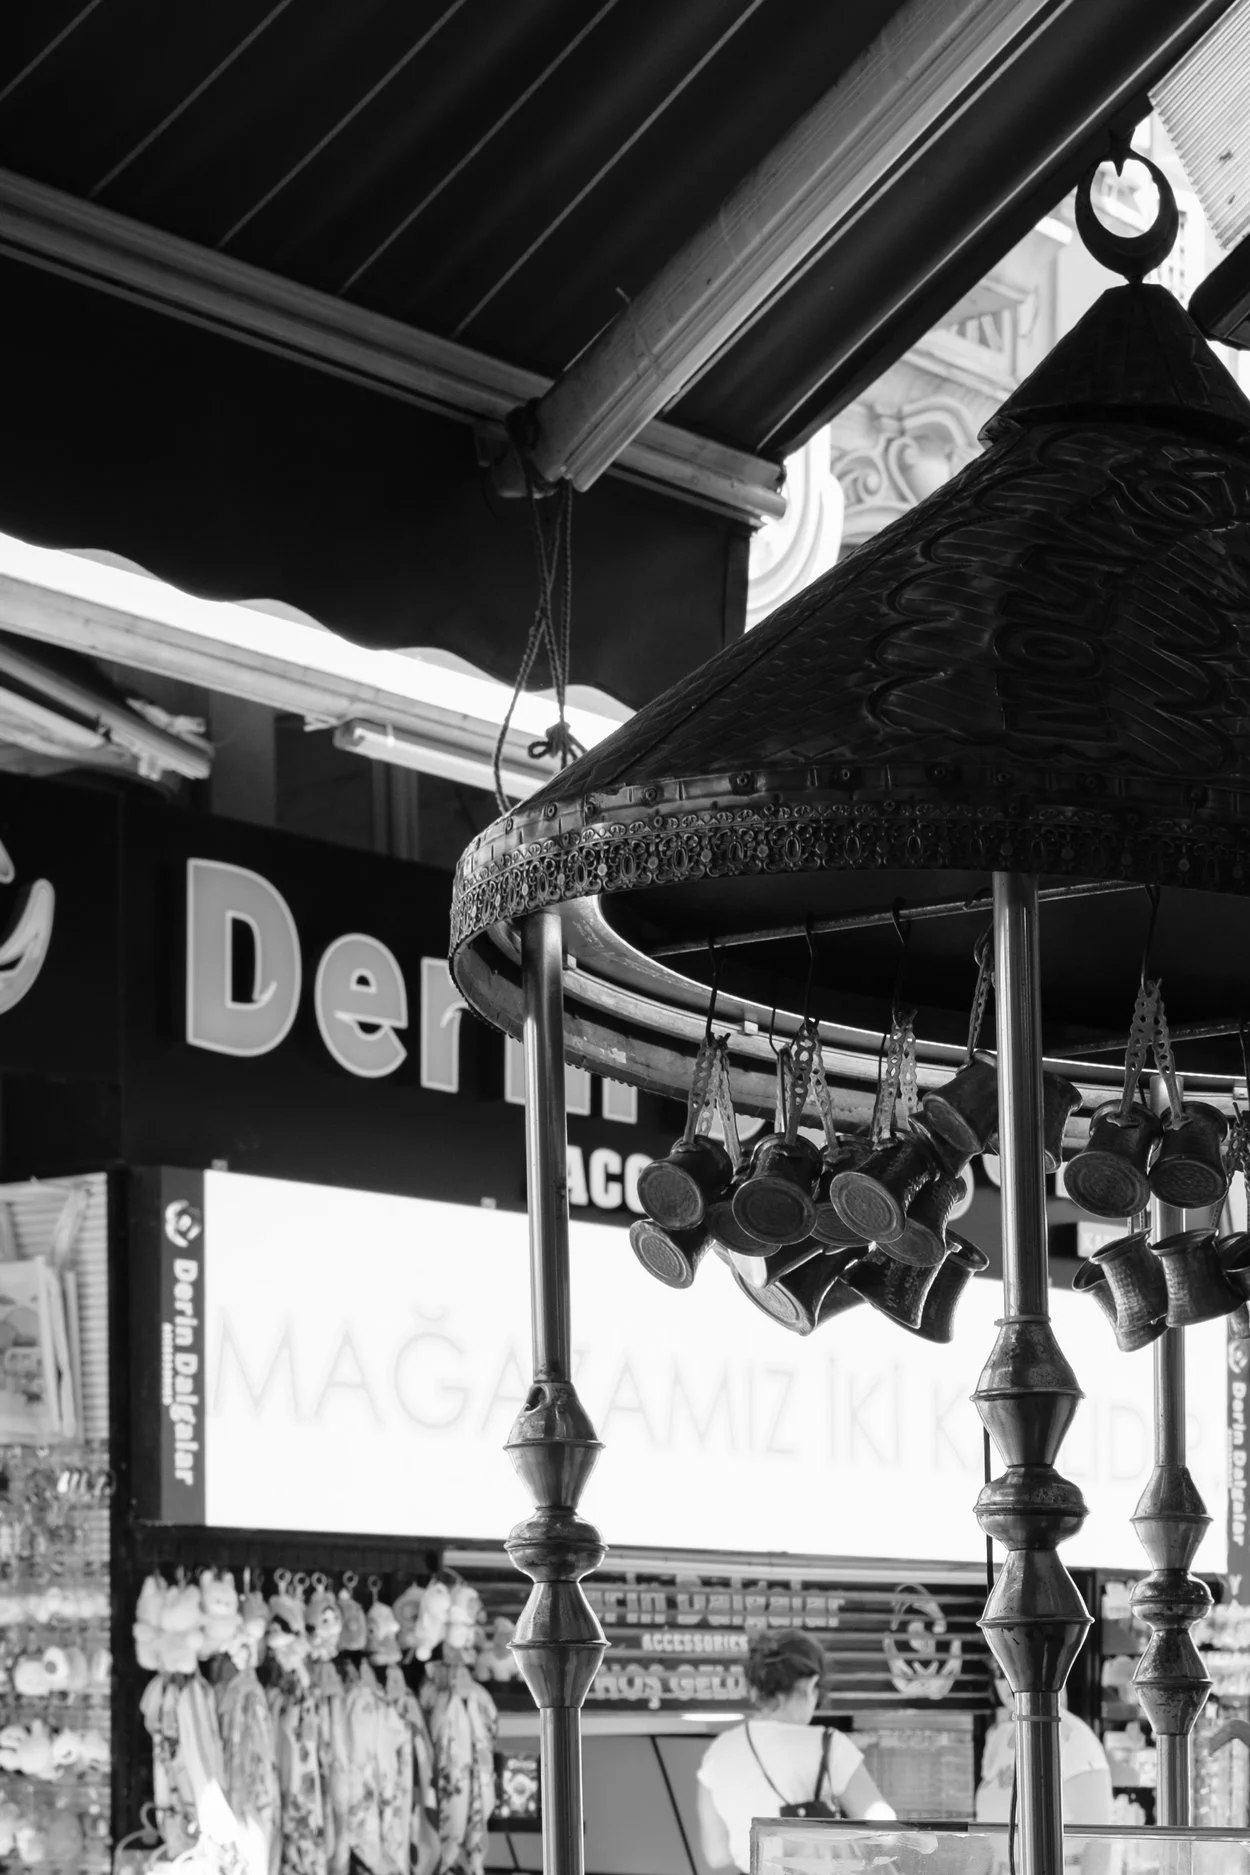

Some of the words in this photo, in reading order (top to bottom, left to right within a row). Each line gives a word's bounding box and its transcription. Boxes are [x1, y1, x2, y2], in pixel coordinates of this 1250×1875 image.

[173, 1257, 199, 1346] Derin
[169, 1352, 199, 1486] Dalgalar
[205, 1302, 798, 1458] MAĞAAMIZ
[1231, 1380, 1248, 1447] Derin
[642, 1632, 749, 1654] ACCESSORIES
